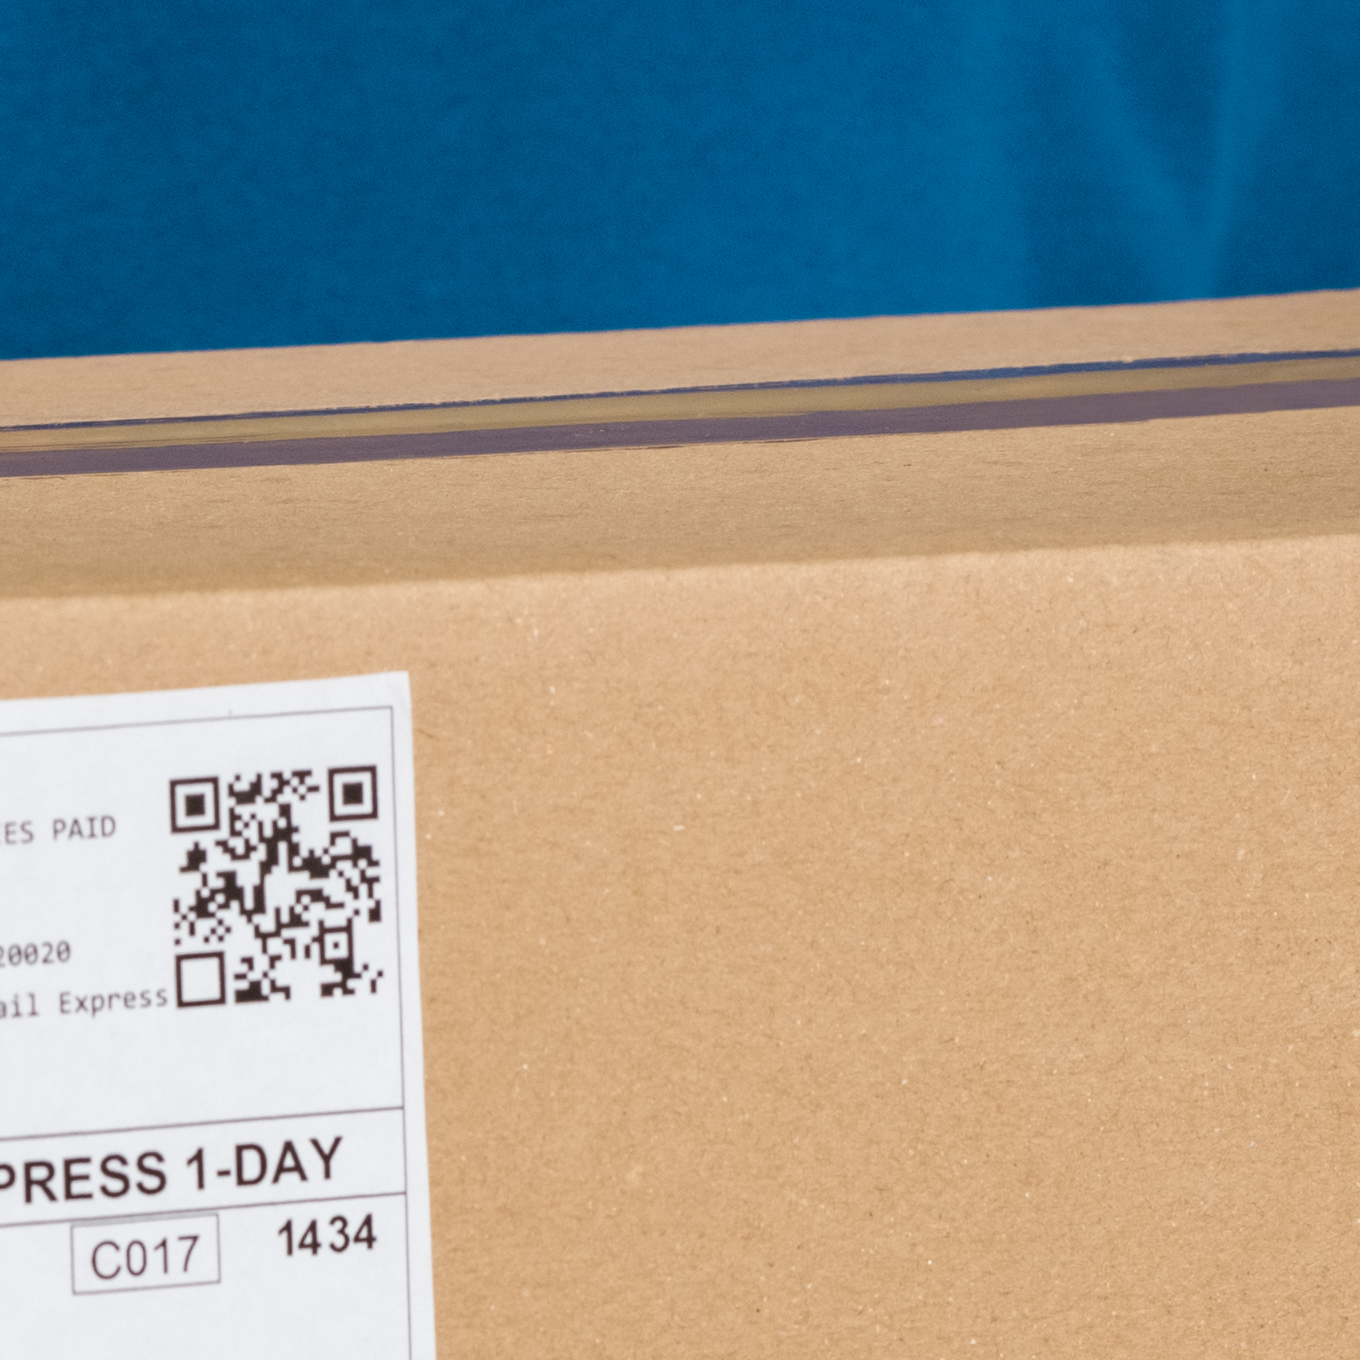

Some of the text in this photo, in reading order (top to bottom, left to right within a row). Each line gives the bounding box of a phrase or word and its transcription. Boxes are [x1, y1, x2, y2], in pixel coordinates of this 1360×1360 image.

[52, 815, 116, 840] PAID
[59, 989, 168, 1017] Express
[186, 1135, 343, 1191] 1-DAY
[278, 1213, 378, 1257] 1434
[90, 1234, 200, 1281] C017
